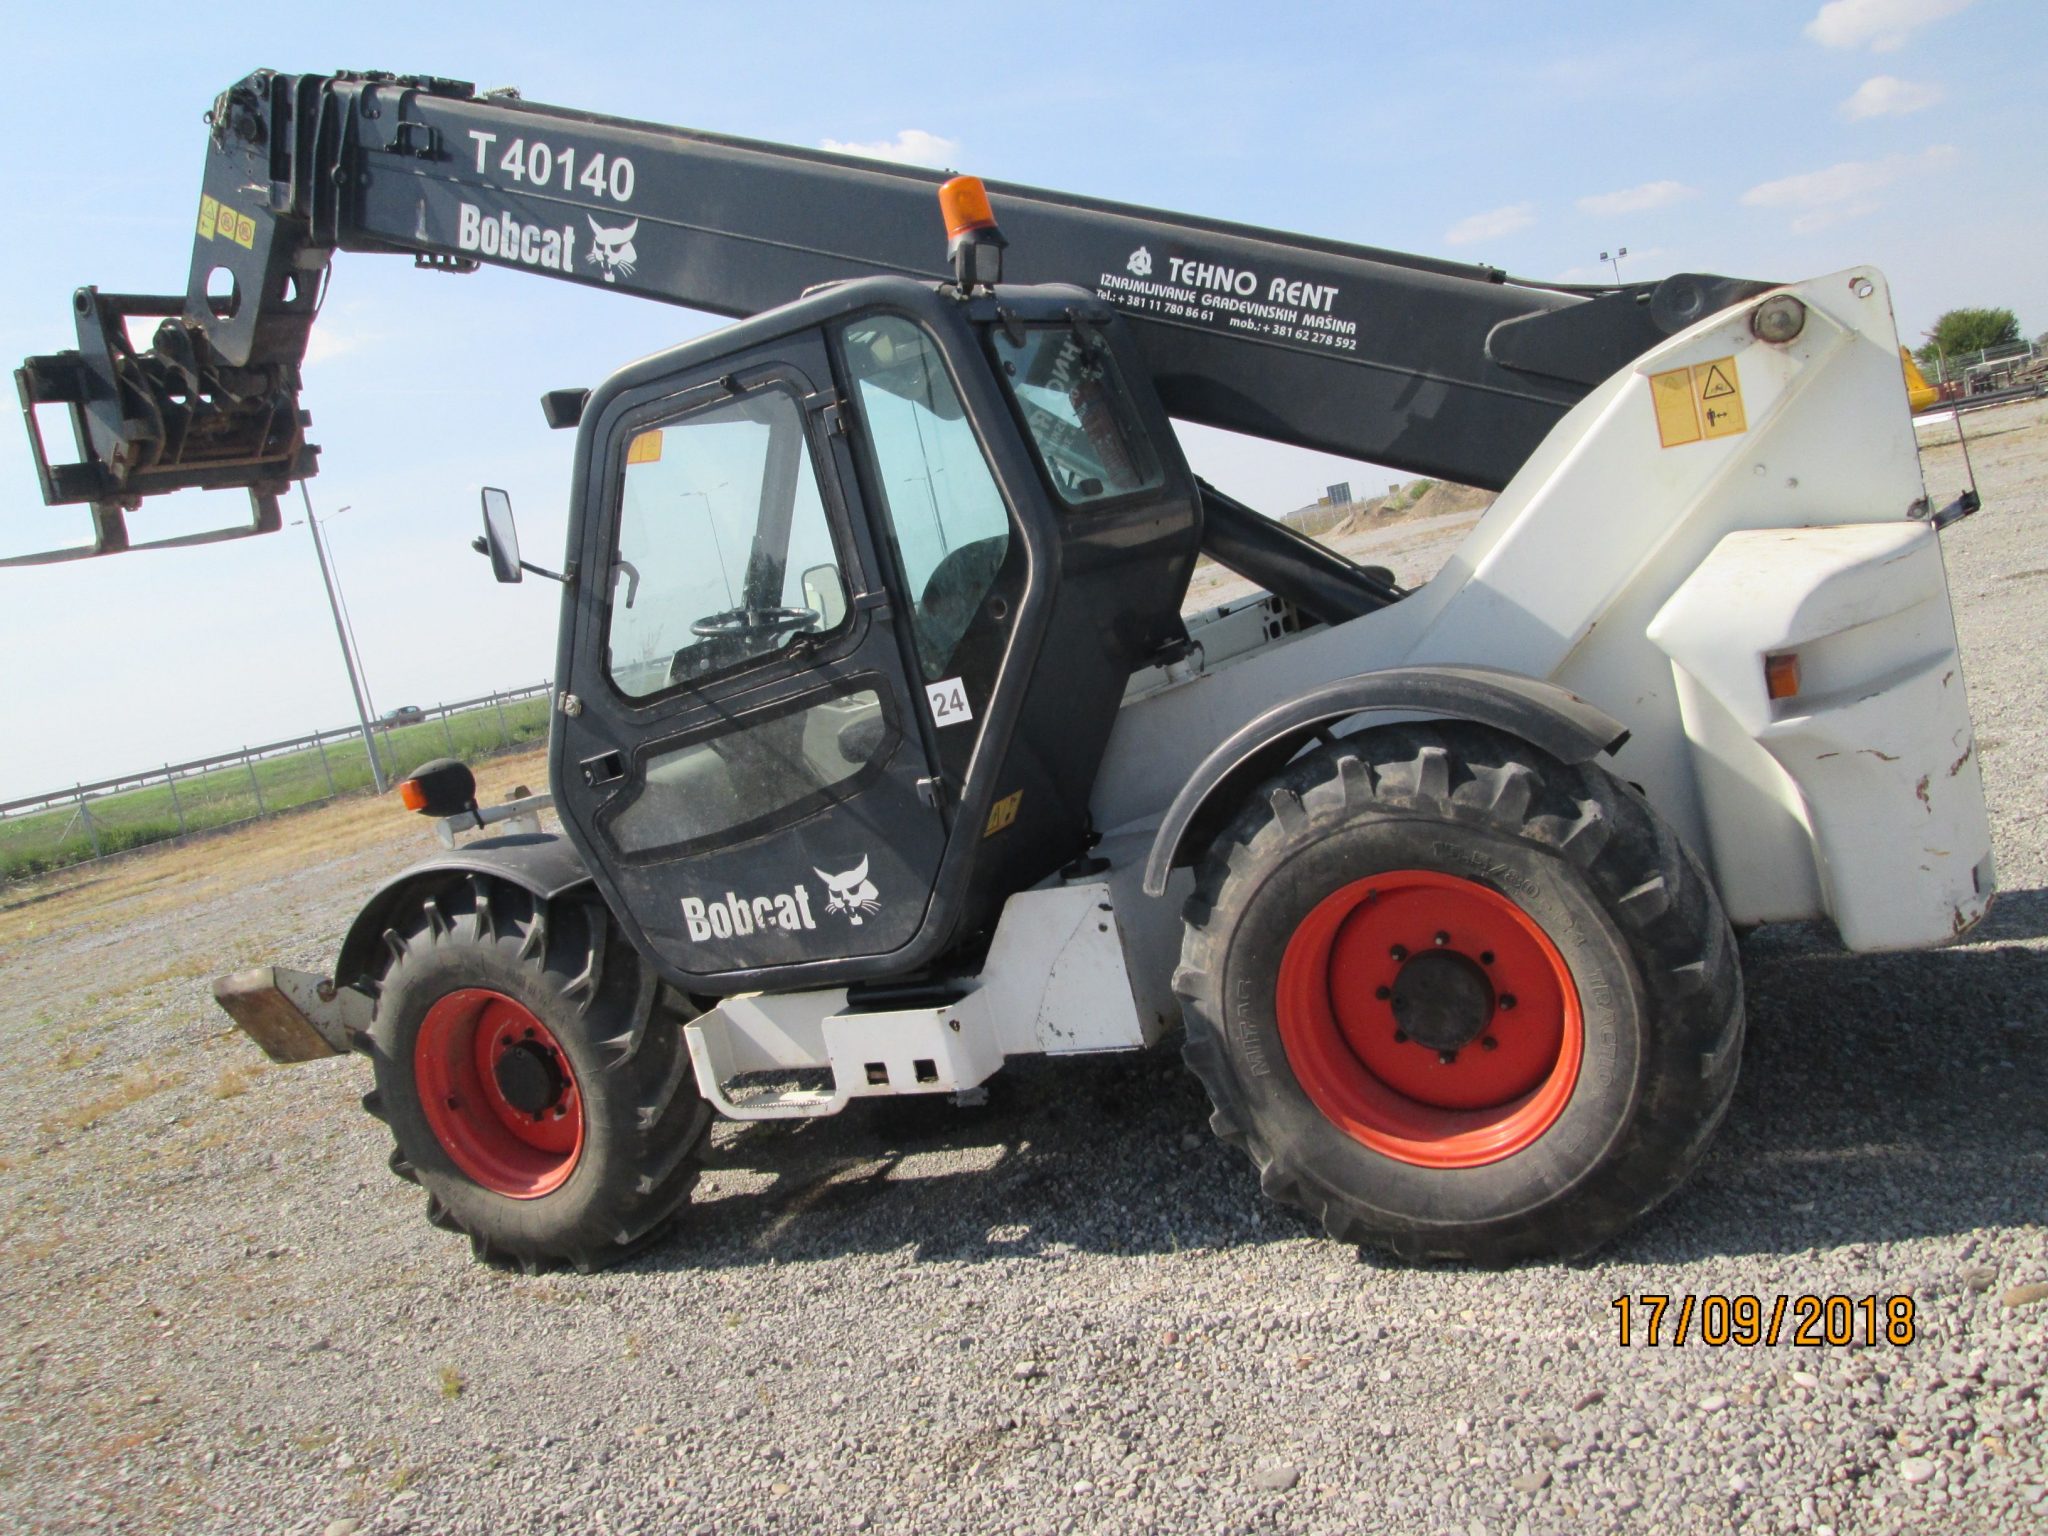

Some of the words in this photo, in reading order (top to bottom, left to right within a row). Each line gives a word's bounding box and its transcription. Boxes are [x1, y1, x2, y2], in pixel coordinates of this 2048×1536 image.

[468, 130, 497, 175] T
[501, 139, 635, 202] 40140
[458, 202, 576, 273] Bobcat
[1169, 256, 1257, 295] TEHNO
[1268, 277, 1339, 312] RENT
[1096, 288, 1116, 302] Tel.:
[1127, 295, 1146, 308] 381
[1149, 299, 1161, 311] 11
[1164, 302, 1184, 315] 780
[1185, 306, 1199, 318] 86
[1200, 310, 1214, 321] 61
[1229, 317, 1261, 331] mob.:
[1272, 324, 1292, 337] 381
[1295, 329, 1309, 341] 62
[1311, 332, 1333, 345] 278
[1334, 336, 1357, 350] 592
[1302, 313, 1357, 335] MAŠINA
[933, 688, 964, 717] 24
[681, 884, 817, 943] Bobcat
